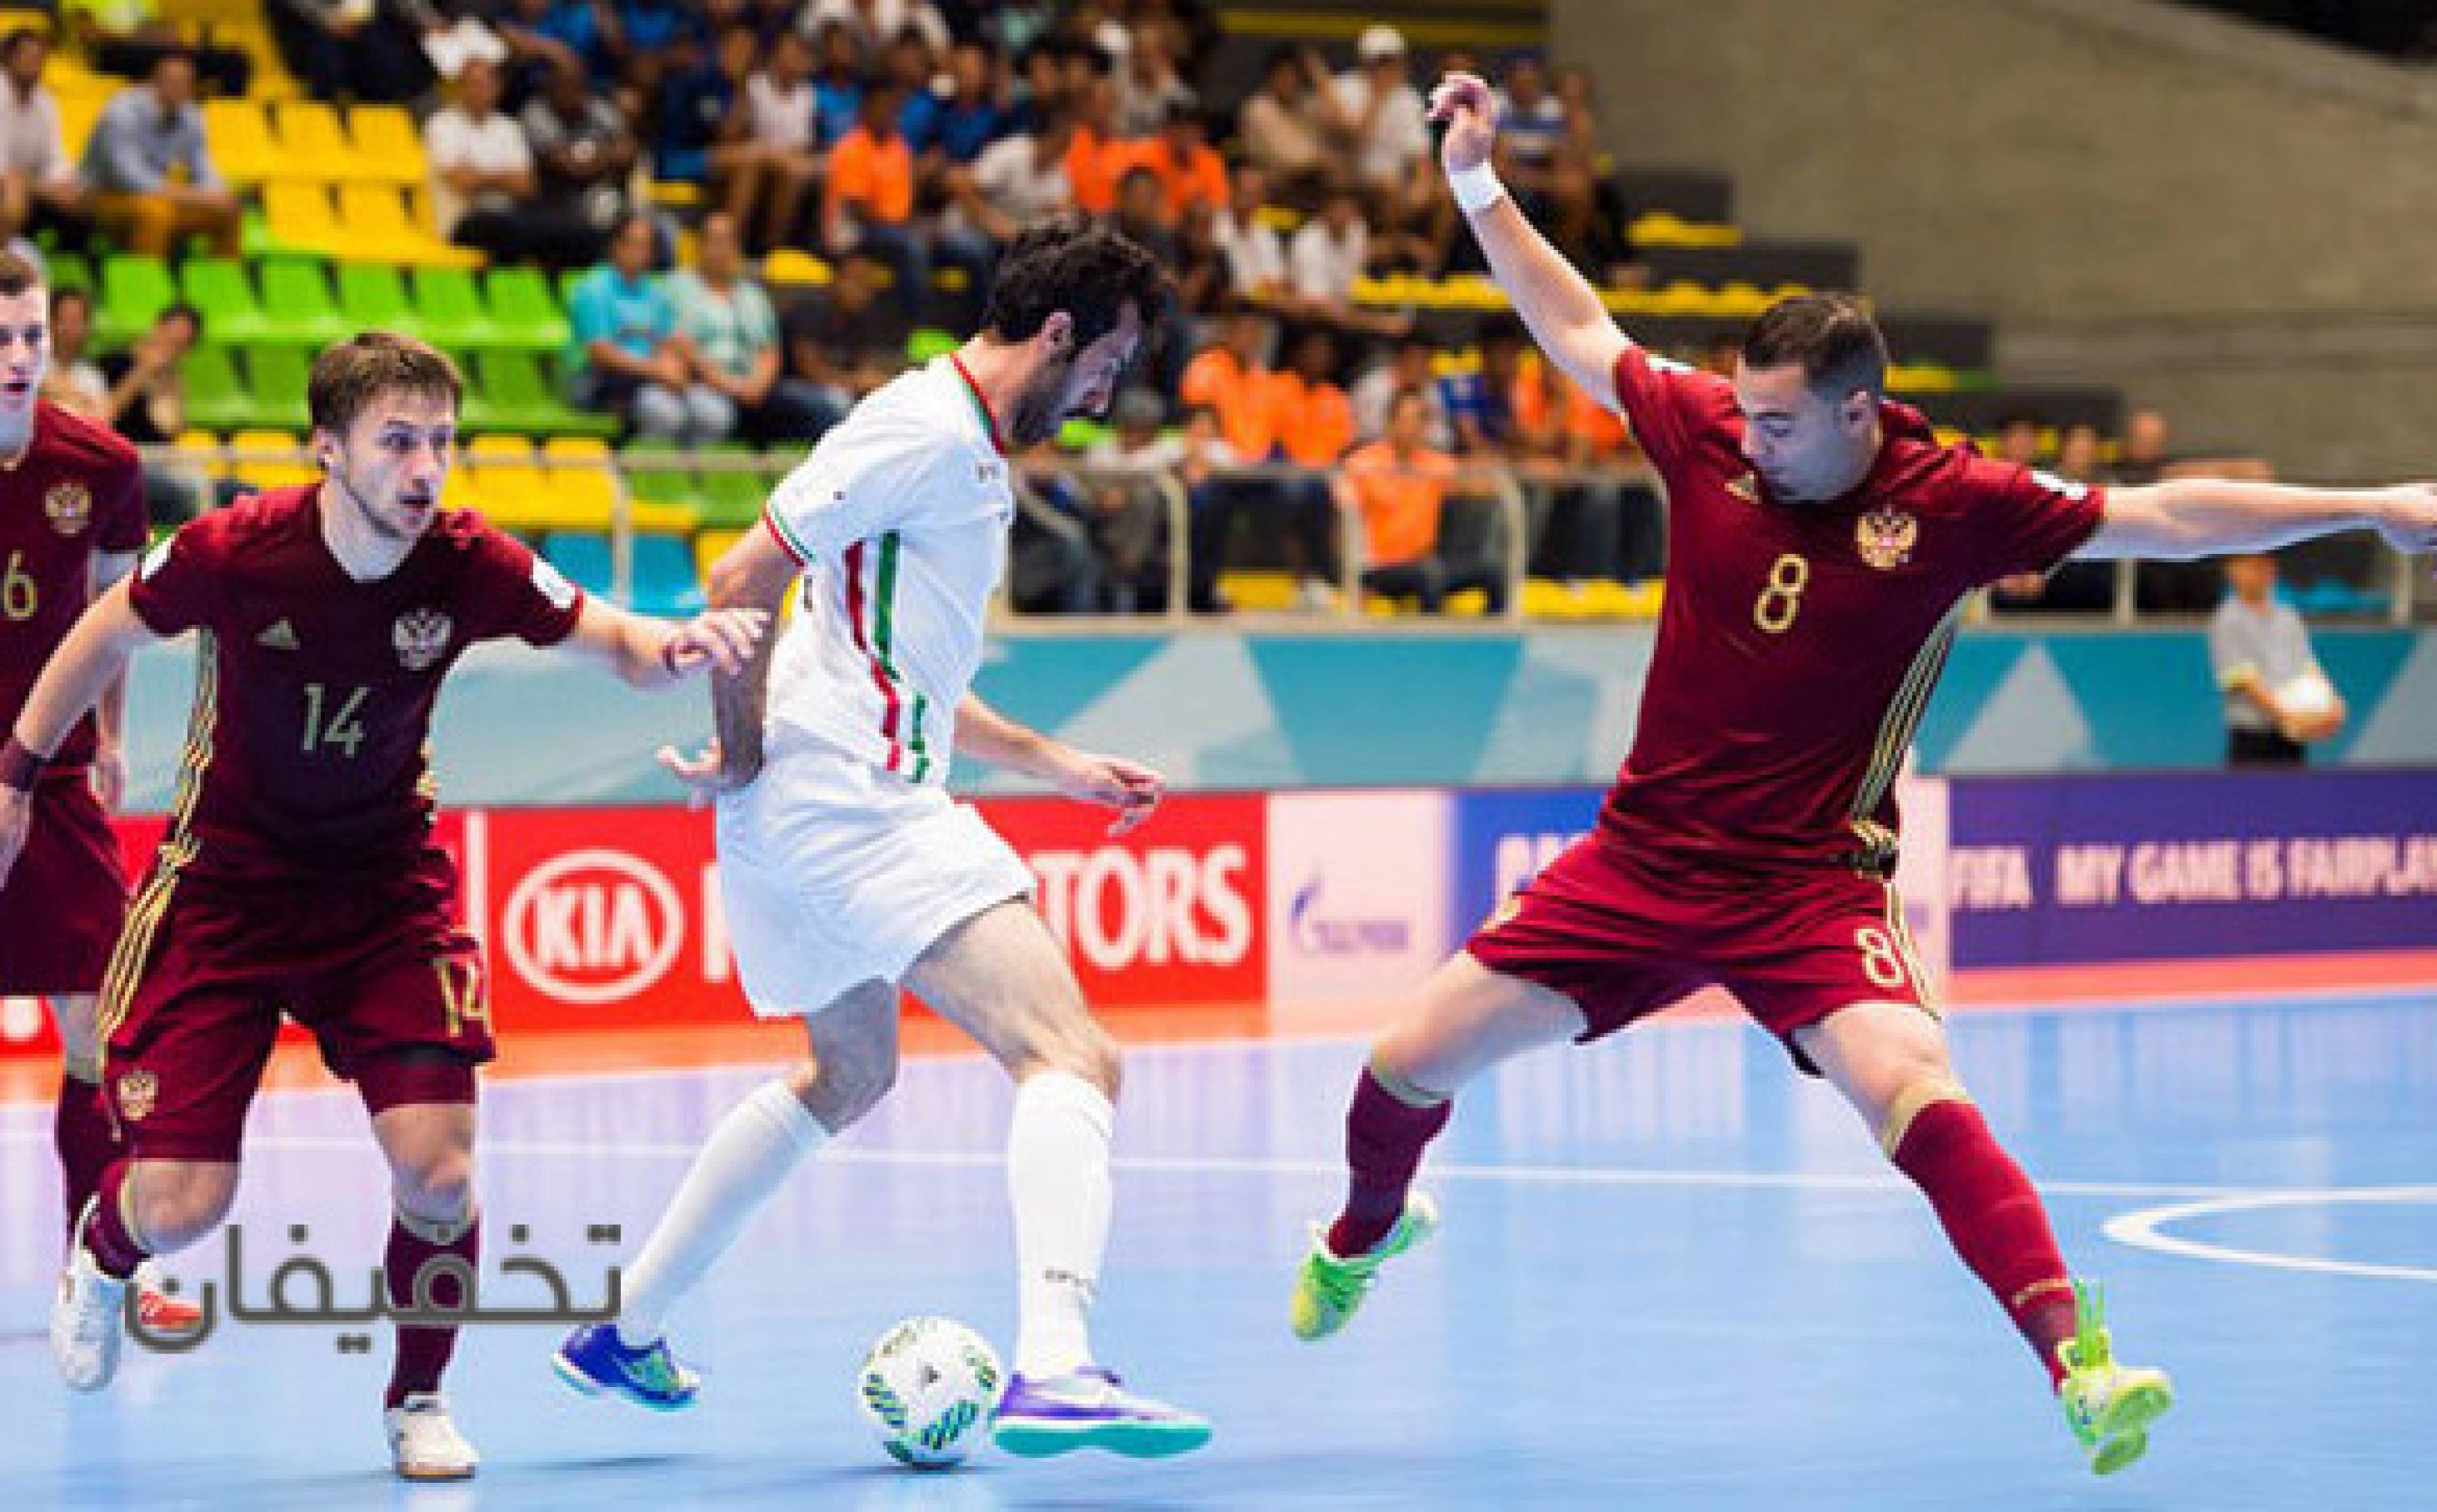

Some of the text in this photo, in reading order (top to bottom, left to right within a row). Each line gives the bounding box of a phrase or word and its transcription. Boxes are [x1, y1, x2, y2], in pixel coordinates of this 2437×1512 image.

[1754, 554, 1809, 633] 8
[303, 683, 371, 756] 14
[1029, 845, 1252, 968] TORS
[2057, 845, 2124, 905] MY
[2130, 841, 2240, 903] GAME
[2247, 839, 2283, 898] IS
[533, 884, 654, 968] KIA
[1856, 926, 1903, 987] 8
[433, 957, 488, 1036] 14
